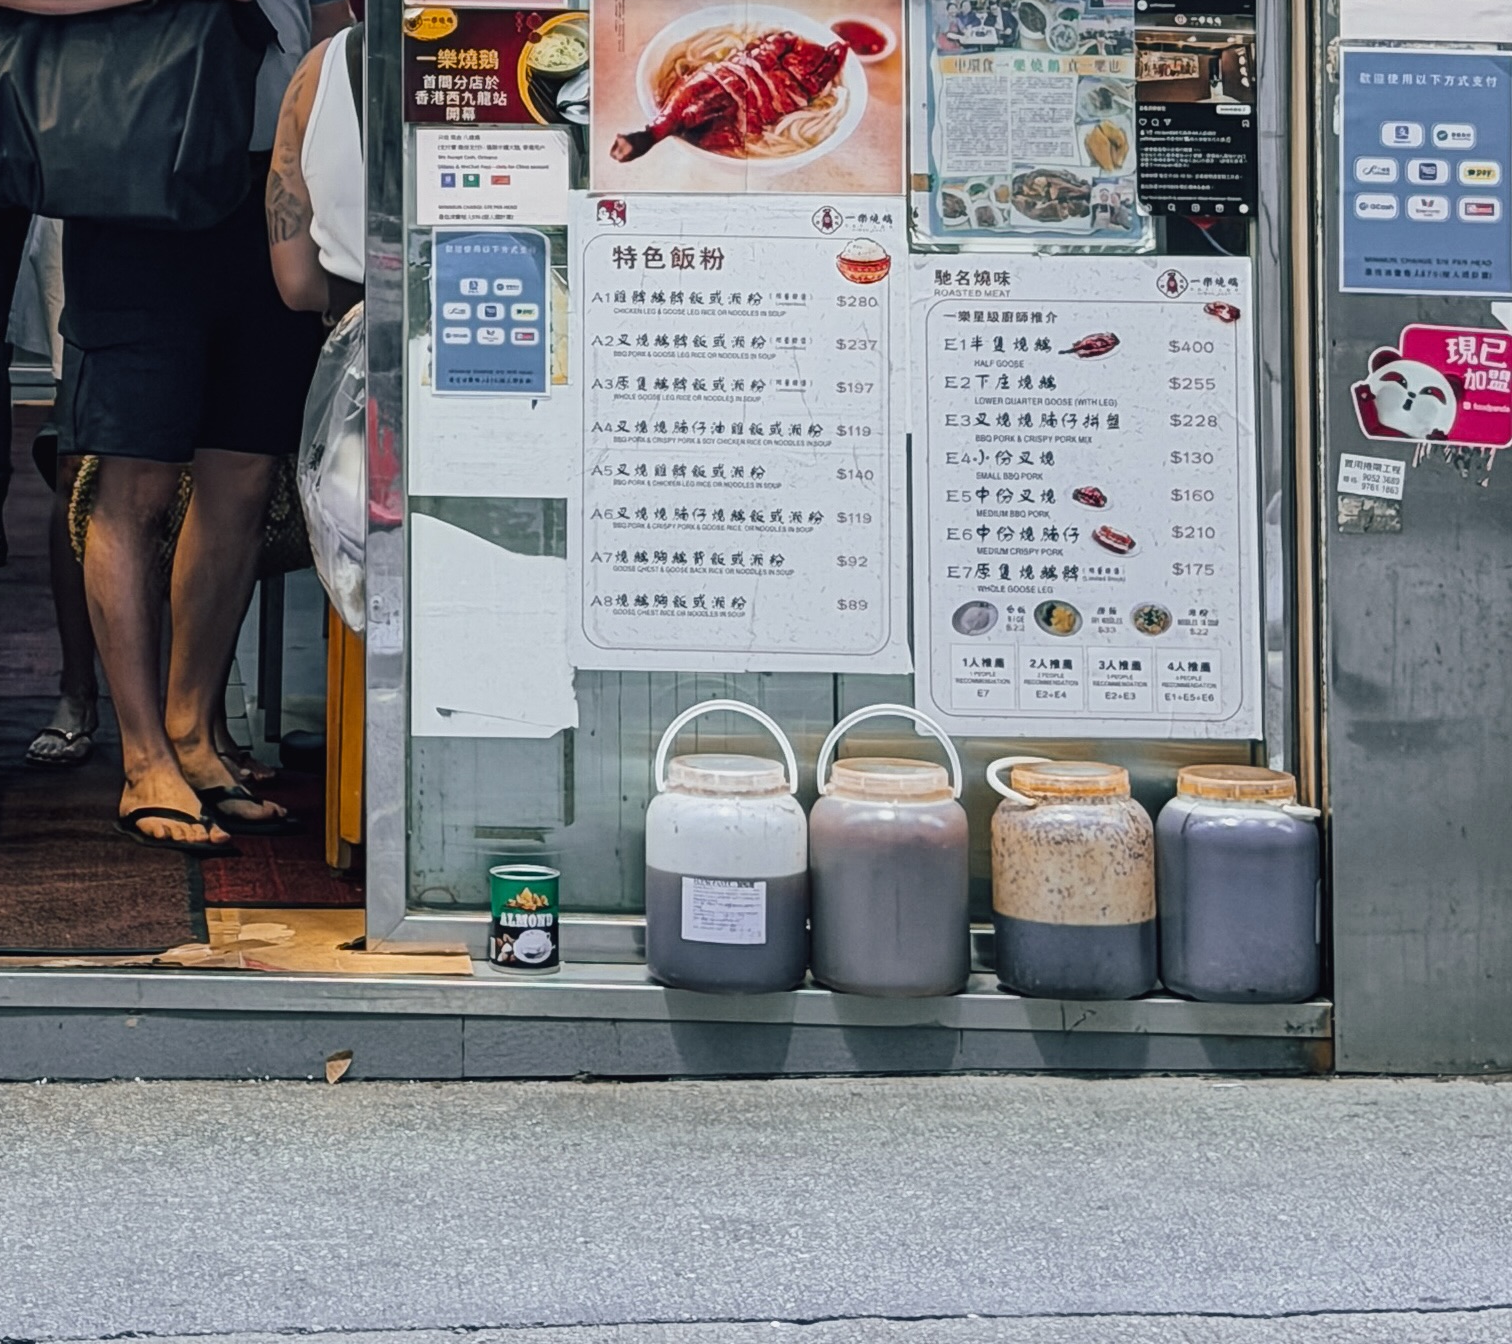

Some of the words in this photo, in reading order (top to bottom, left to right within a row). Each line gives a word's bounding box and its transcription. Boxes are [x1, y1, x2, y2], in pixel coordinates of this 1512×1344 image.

[416, 48, 499, 70] 一樂燒鵝
[414, 91, 507, 106] 香港西九龍站
[446, 107, 476, 121] 開幕
[612, 245, 725, 270] 特色飯粉
[934, 269, 1011, 287] 馳名燒味
[934, 290, 982, 298] ROASTED
[984, 290, 1011, 298] MEAT
[836, 295, 878, 308] $280
[836, 339, 878, 351] $237
[1168, 341, 1214, 354] $400
[1168, 377, 1216, 390] $255
[1464, 368, 1510, 393] 加盟
[836, 382, 873, 393] $197
[1170, 415, 1217, 428] $228
[837, 425, 871, 437] $119
[1170, 451, 1214, 465] $130
[836, 469, 873, 481] $140
[1171, 489, 1215, 502] $160
[837, 512, 872, 524] $119
[1171, 526, 1216, 539] $210
[837, 555, 868, 568] $92
[1172, 563, 1215, 576] $175
[837, 599, 868, 611] $89
[500, 912, 553, 927] ALMOND
